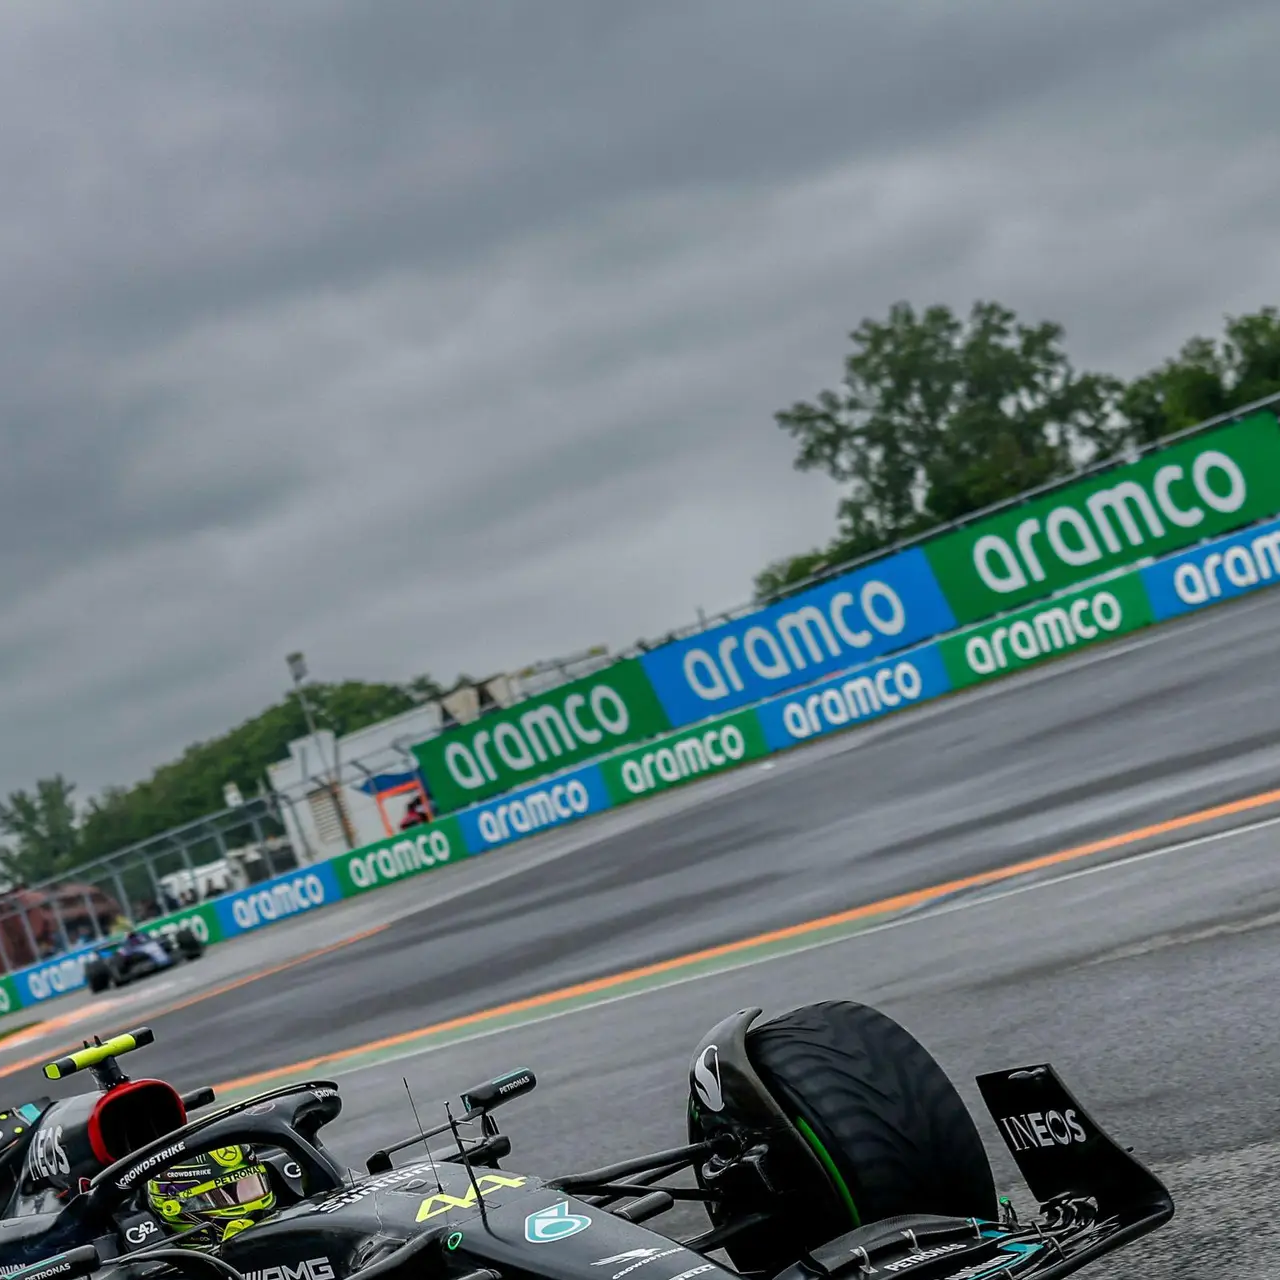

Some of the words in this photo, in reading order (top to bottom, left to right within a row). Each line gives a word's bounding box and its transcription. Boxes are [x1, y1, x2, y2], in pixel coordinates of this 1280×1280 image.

[973, 451, 1246, 593] aramco
[683, 580, 906, 700] aramco
[966, 592, 1122, 674] aramco
[783, 661, 922, 738] aramco
[445, 685, 629, 789] aramco
[621, 724, 745, 794] aramco
[479, 779, 589, 843] aramco
[349, 830, 450, 888] aramco
[232, 873, 325, 928] aramco
[499, 1076, 530, 1094] PETRONAS
[1000, 1109, 1087, 1151] INEOS
[117, 1141, 186, 1187] CROWDSTRIKE
[167, 1168, 211, 1178] CROWDSTRIKE
[125, 1220, 159, 1244] G42
